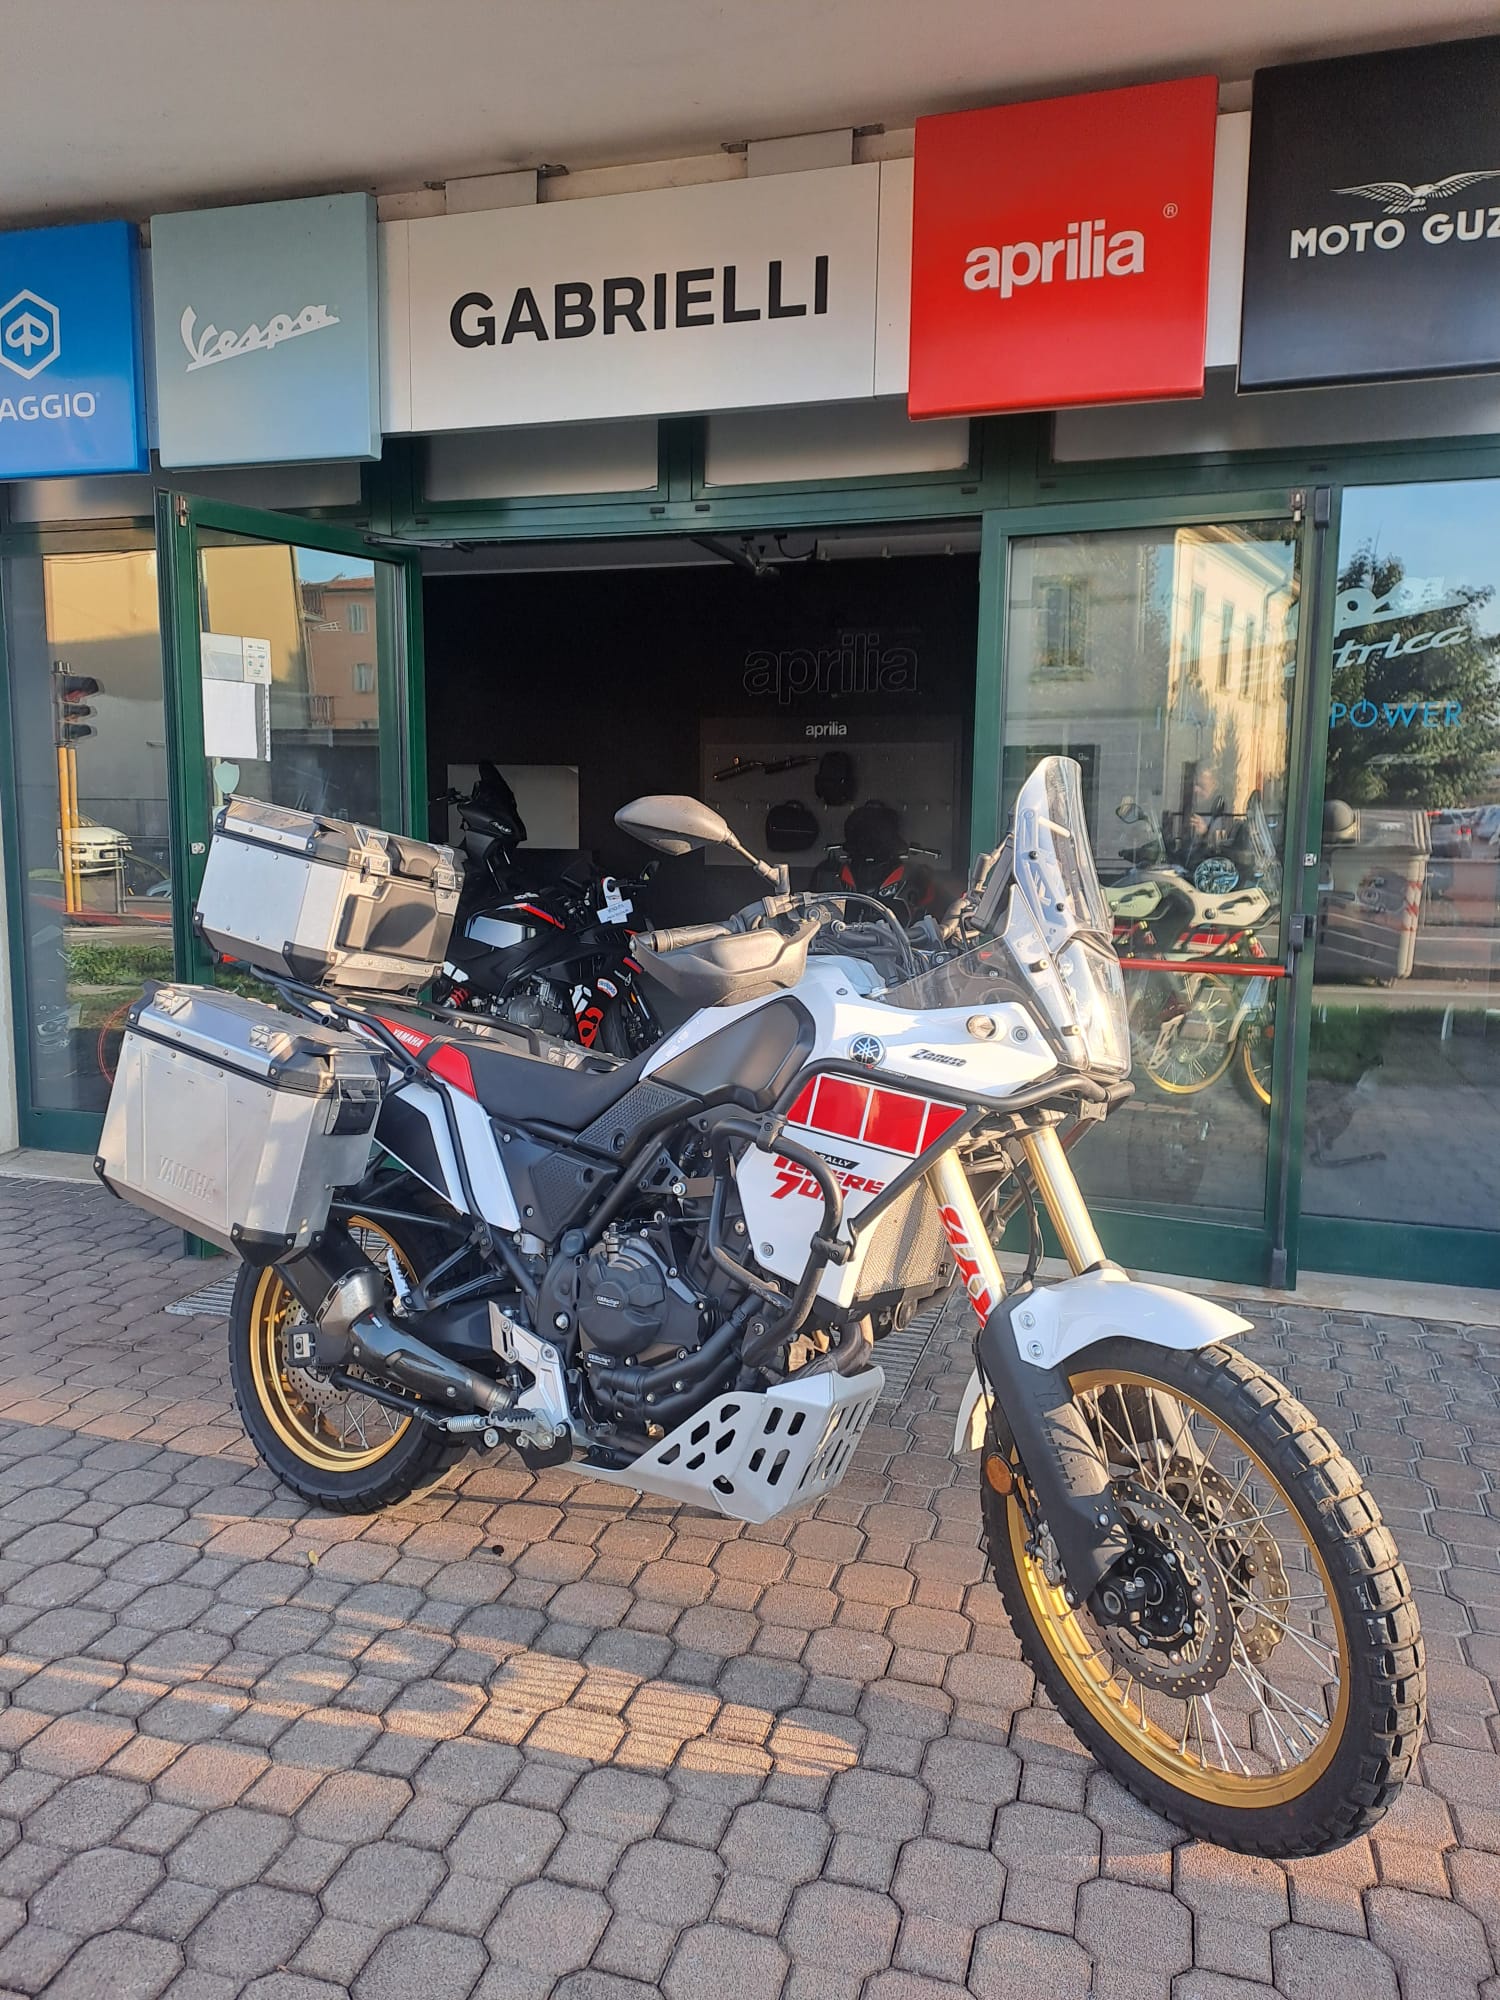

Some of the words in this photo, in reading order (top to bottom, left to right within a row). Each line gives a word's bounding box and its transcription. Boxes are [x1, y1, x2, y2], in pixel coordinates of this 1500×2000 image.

[963, 218, 1145, 299] aprilia
[1289, 218, 1406, 259] MOTO
[449, 255, 829, 348] GABRIELLI
[180, 304, 340, 373] Vespa
[0, 391, 96, 422] AGGIO
[743, 632, 919, 705] aprilia
[805, 721, 848, 738] aprilia
[1329, 699, 1463, 729] POWER
[392, 1027, 425, 1048] YAMAHA
[157, 1153, 217, 1206] YAMAHA
